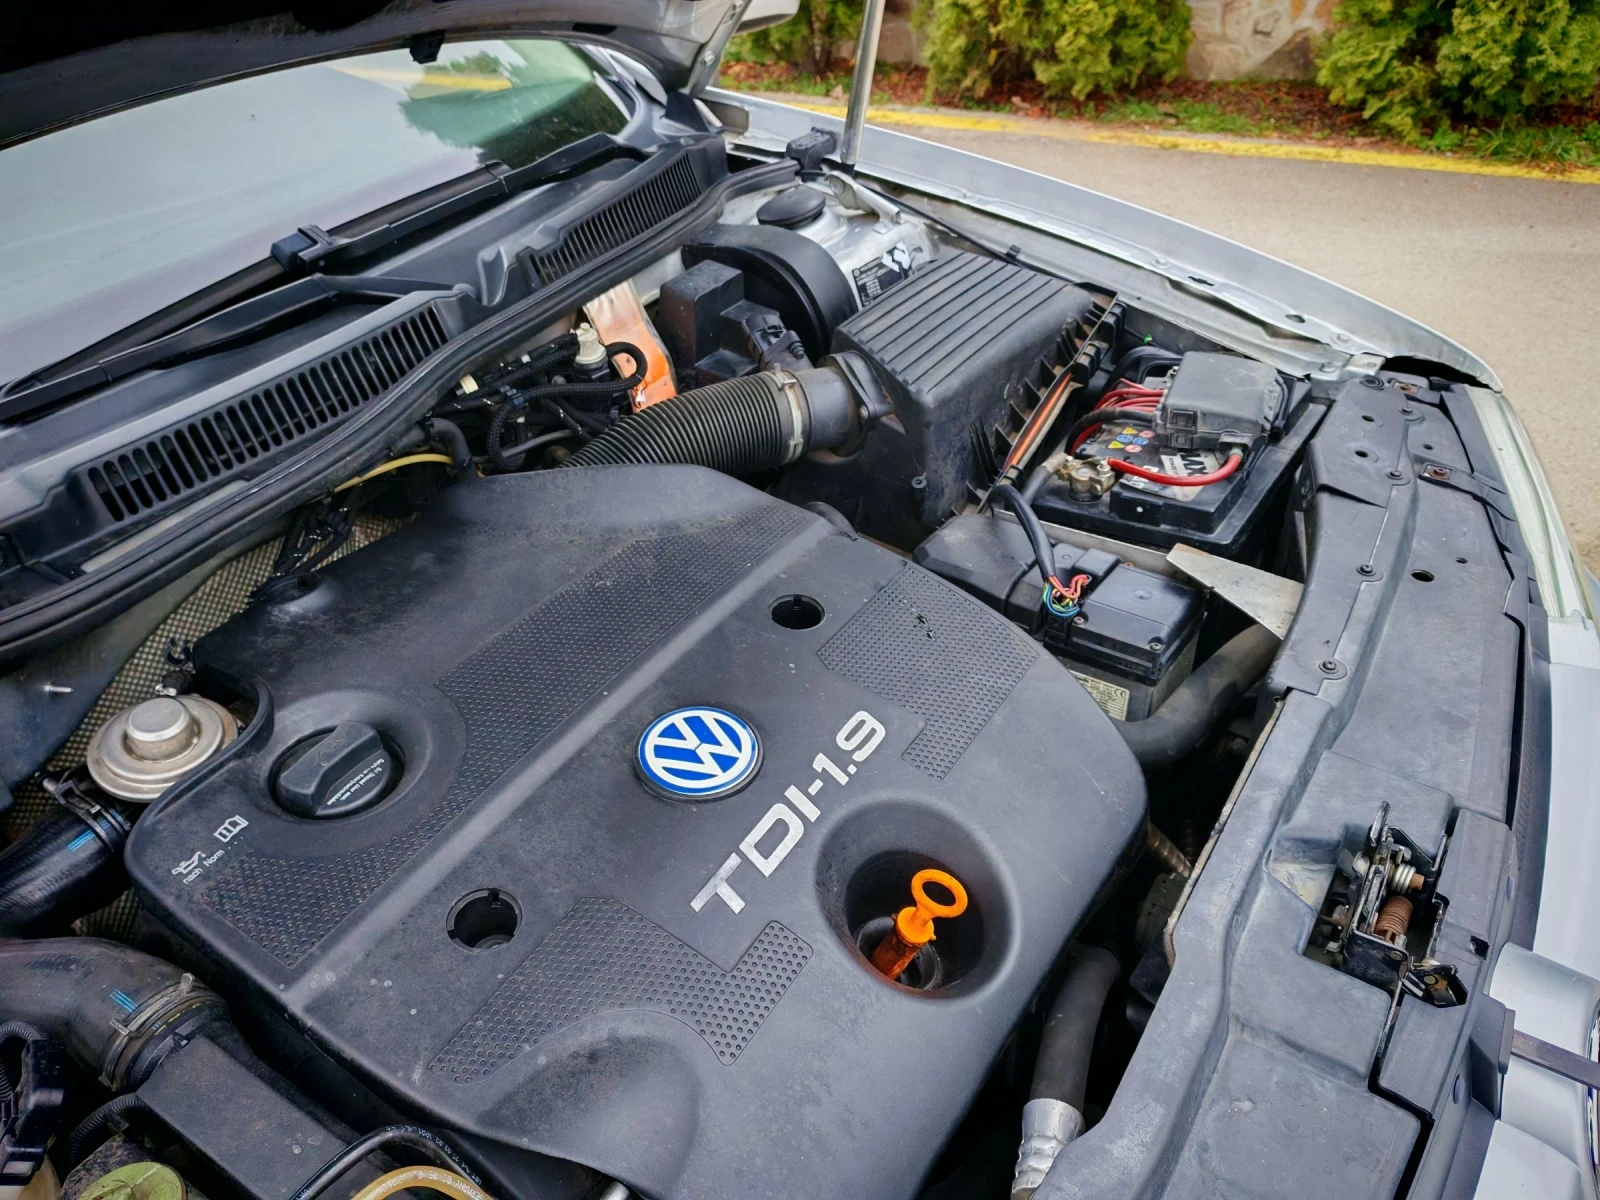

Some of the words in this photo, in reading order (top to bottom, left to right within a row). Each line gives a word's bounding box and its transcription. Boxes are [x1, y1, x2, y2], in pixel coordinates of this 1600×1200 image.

[644, 709, 752, 788] VW
[690, 710, 886, 915] TDI-1.9
[182, 867, 203, 884] nach
[203, 849, 225, 866] Norm
